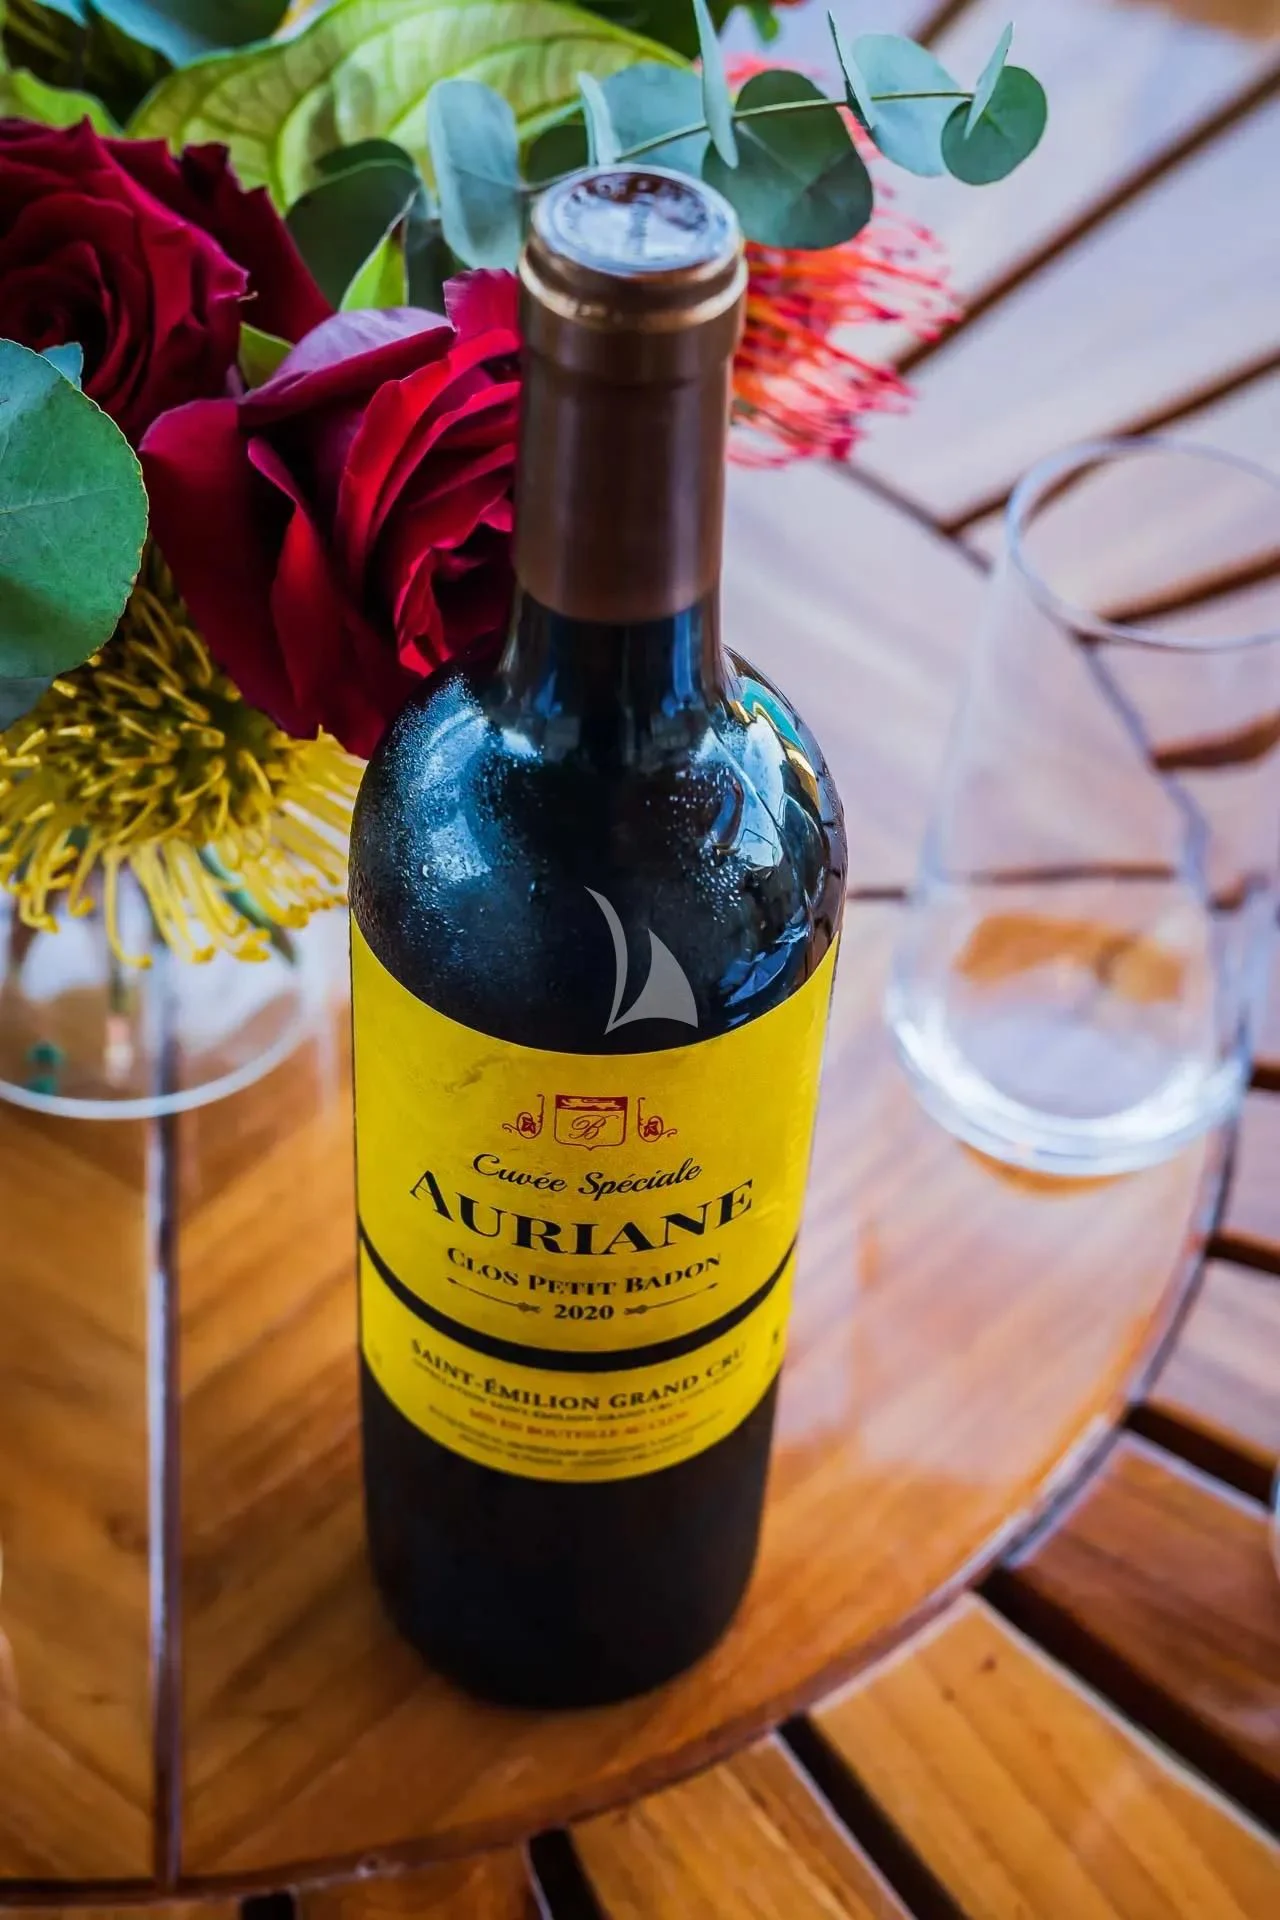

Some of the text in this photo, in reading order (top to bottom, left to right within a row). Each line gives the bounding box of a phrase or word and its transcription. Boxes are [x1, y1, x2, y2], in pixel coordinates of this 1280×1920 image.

[472, 1153, 702, 1201] Cuvée Spéciale
[409, 1169, 754, 1256] AURIANE
[447, 1247, 721, 1296] CLOS PETIT BADON
[554, 1304, 615, 1320] 2020
[411, 1338, 600, 1410] SAINT-ÉMILION
[608, 1373, 699, 1409] GRAND
